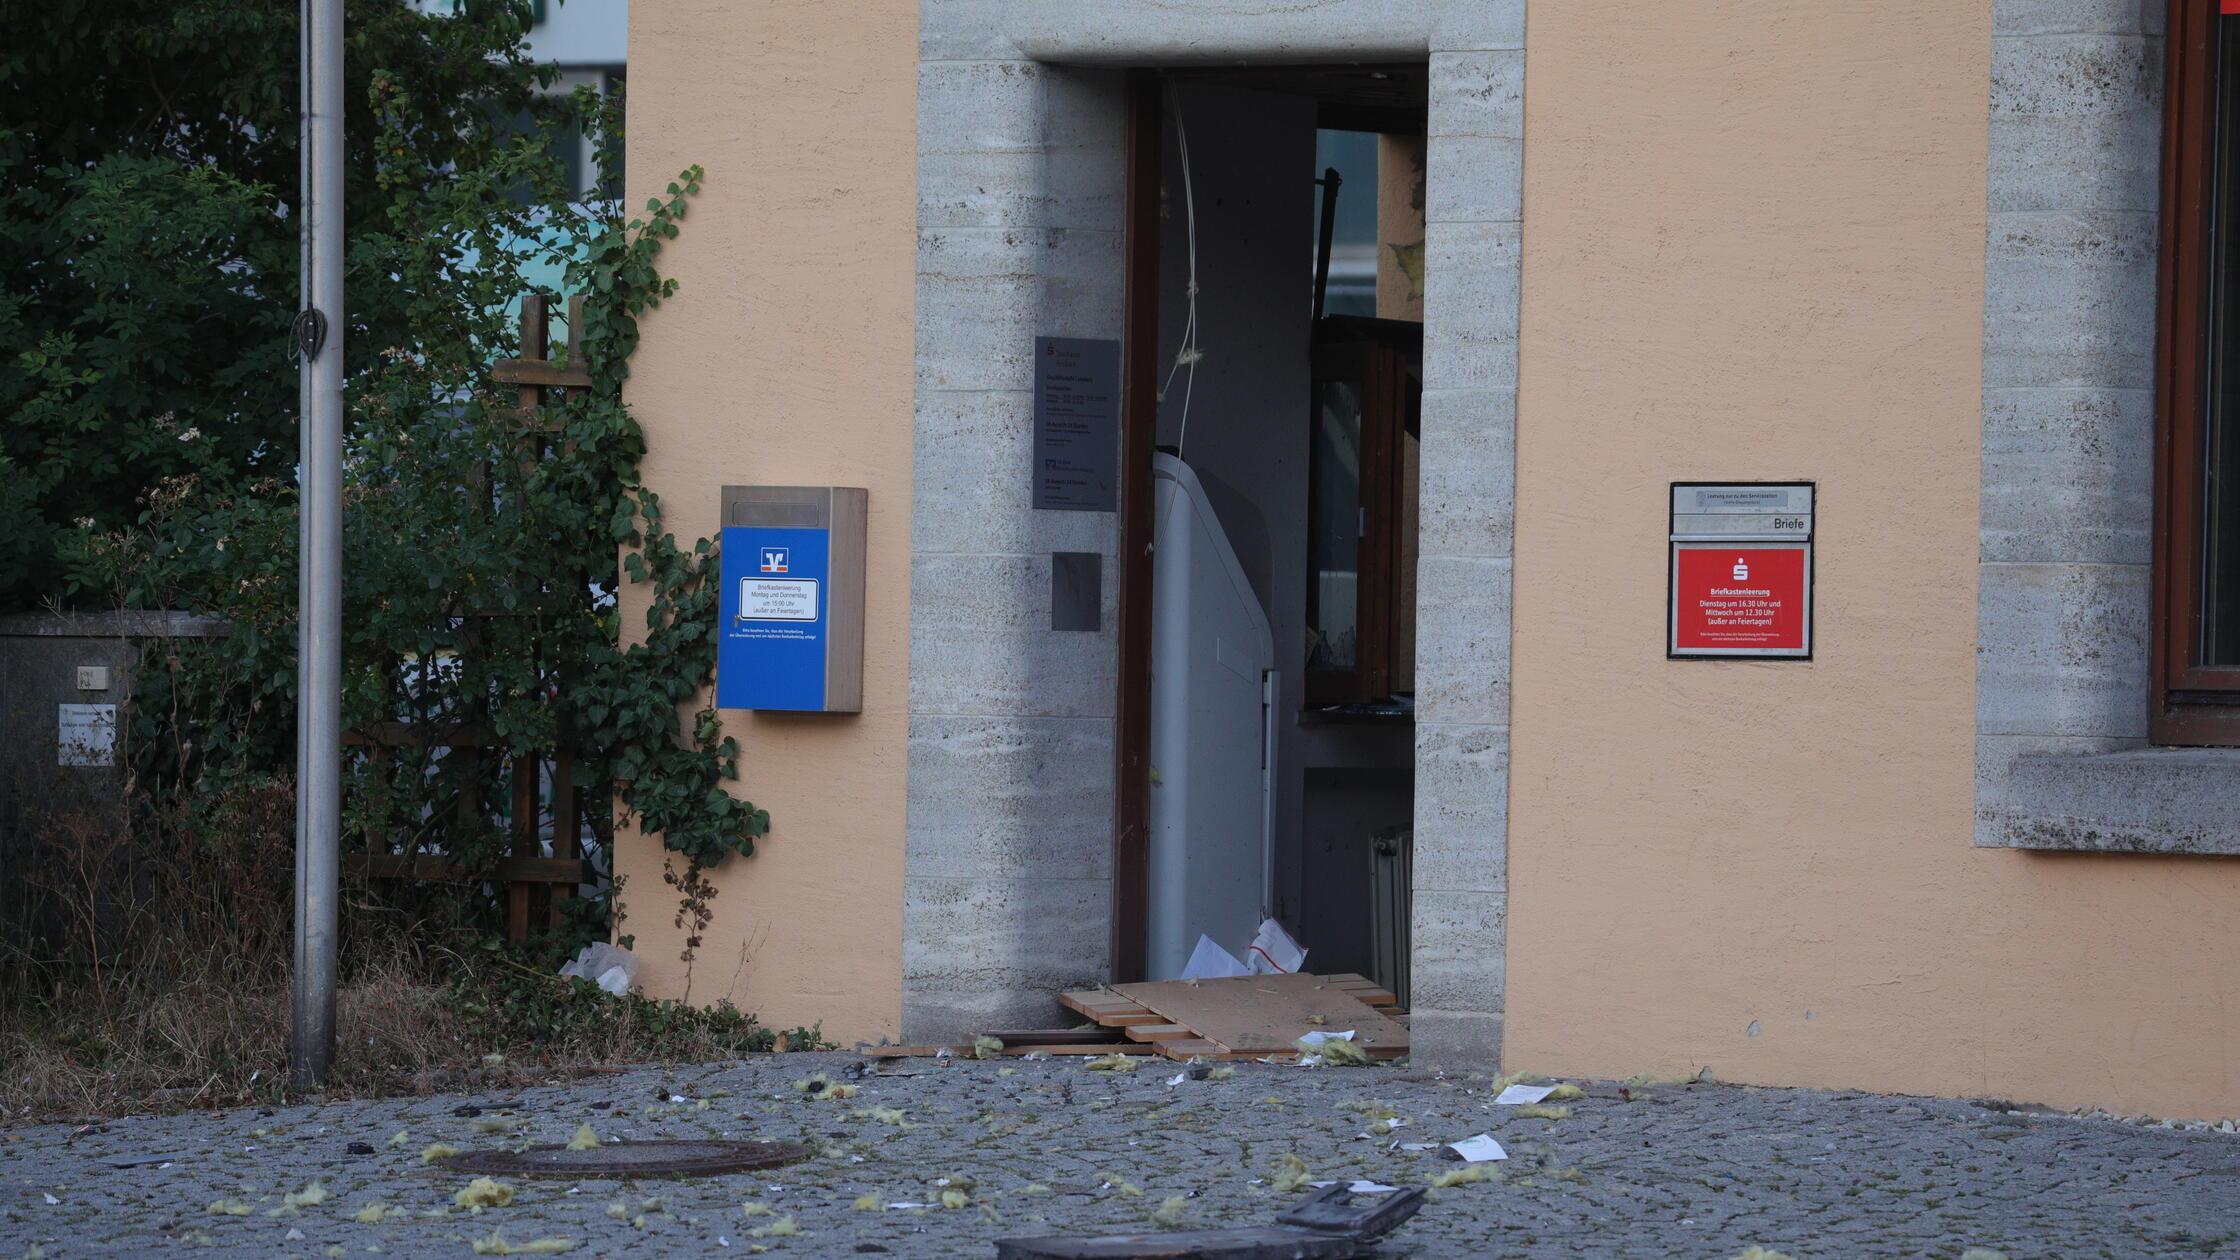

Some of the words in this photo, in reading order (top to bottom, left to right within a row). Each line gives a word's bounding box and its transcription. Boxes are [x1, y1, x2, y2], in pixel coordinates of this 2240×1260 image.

[1774, 517, 1804, 530] Briefe
[1710, 588, 1770, 597] Briefkastenleerung
[1700, 600, 1727, 609] Dienstag
[1708, 617, 1728, 625] (außer
[1737, 617, 1772, 626] Feiertagen)
